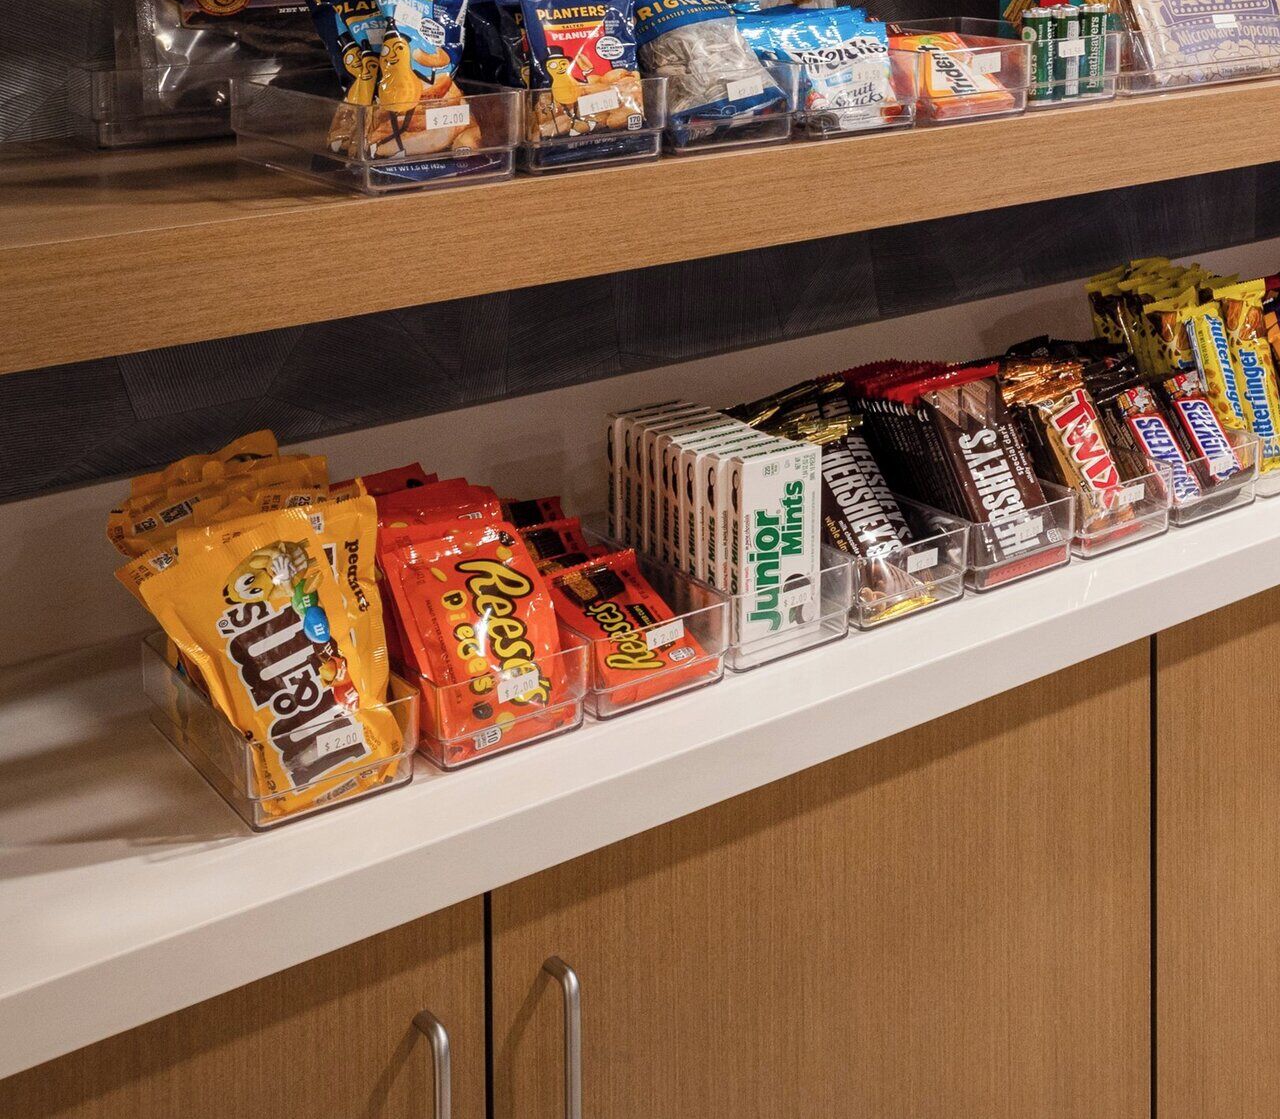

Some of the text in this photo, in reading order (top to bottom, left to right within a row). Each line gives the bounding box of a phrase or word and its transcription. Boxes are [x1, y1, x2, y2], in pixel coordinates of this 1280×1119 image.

[535, 5, 606, 21] PLANTERS
[551, 29, 600, 41] PEANUTS
[1177, 23, 1280, 48] Microwave Popcorn
[791, 39, 887, 73] Welch's
[918, 45, 976, 94] Trident
[1087, 16, 1099, 89] breathsavers
[433, 113, 464, 126] $ 2.00
[1204, 312, 1246, 421] Butterfinger
[1240, 347, 1280, 460] Butterfinger
[999, 425, 1025, 477] special dark
[1050, 388, 1123, 510] TWIX
[1136, 418, 1201, 500] SNICKERS
[781, 479, 804, 556] Mints
[822, 449, 904, 559] HERSHEY'S
[847, 437, 913, 540] HERSHEY'S
[958, 428, 1041, 557] HERSHEY'S
[708, 516, 716, 561] Mints
[731, 520, 739, 566] Mints
[824, 516, 841, 539] whole
[344, 539, 370, 613] peanut
[747, 510, 782, 632] Junior
[456, 559, 552, 709] Reese's
[584, 602, 668, 670] Reese's
[660, 629, 679, 643] 2.00
[513, 679, 533, 695] 2.00
[334, 732, 357, 748] 2.00
